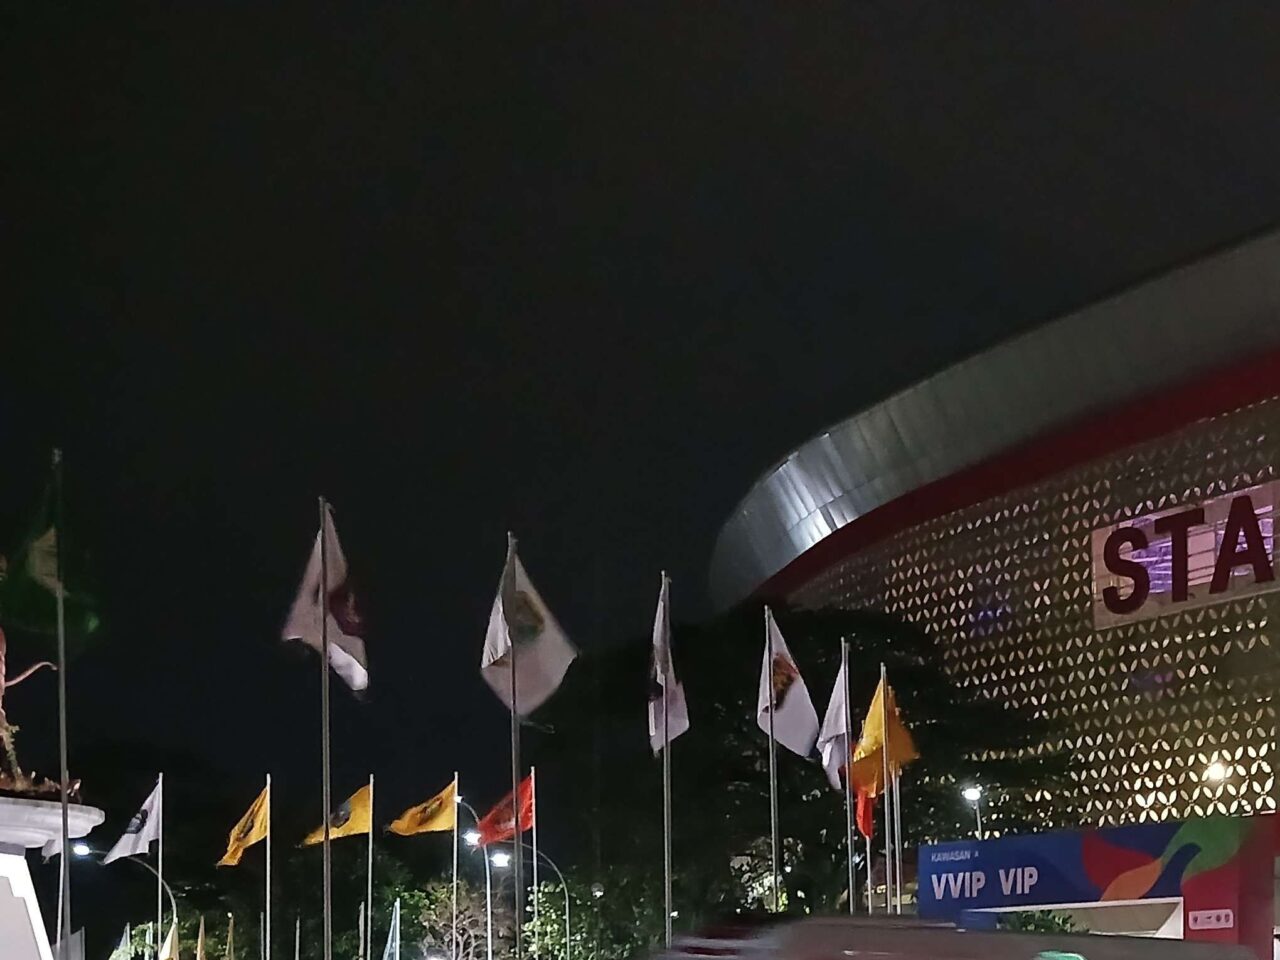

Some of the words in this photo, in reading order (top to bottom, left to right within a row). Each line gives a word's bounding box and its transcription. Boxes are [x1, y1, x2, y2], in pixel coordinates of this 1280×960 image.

[931, 849, 971, 862] KAWASAN
[931, 870, 986, 900] VVIP
[998, 866, 1039, 895] VIP
